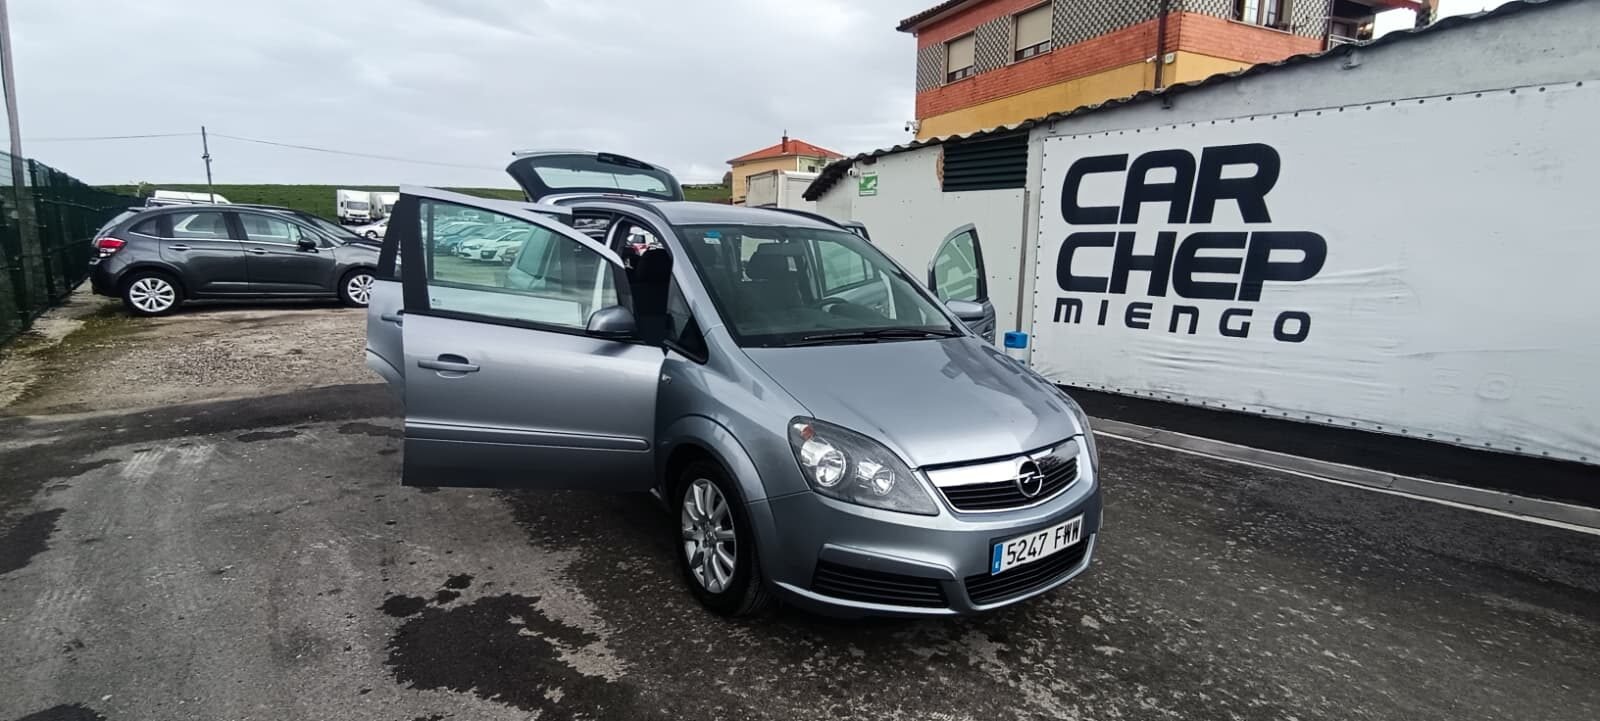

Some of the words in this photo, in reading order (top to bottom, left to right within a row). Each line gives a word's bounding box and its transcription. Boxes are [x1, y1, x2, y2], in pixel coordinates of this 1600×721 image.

[1060, 143, 1280, 225] CAR
[1056, 231, 1328, 302] CHEP
[1053, 297, 1311, 342] MIENGO
[1007, 532, 1048, 565] 5247
[1054, 519, 1081, 549] FWW
